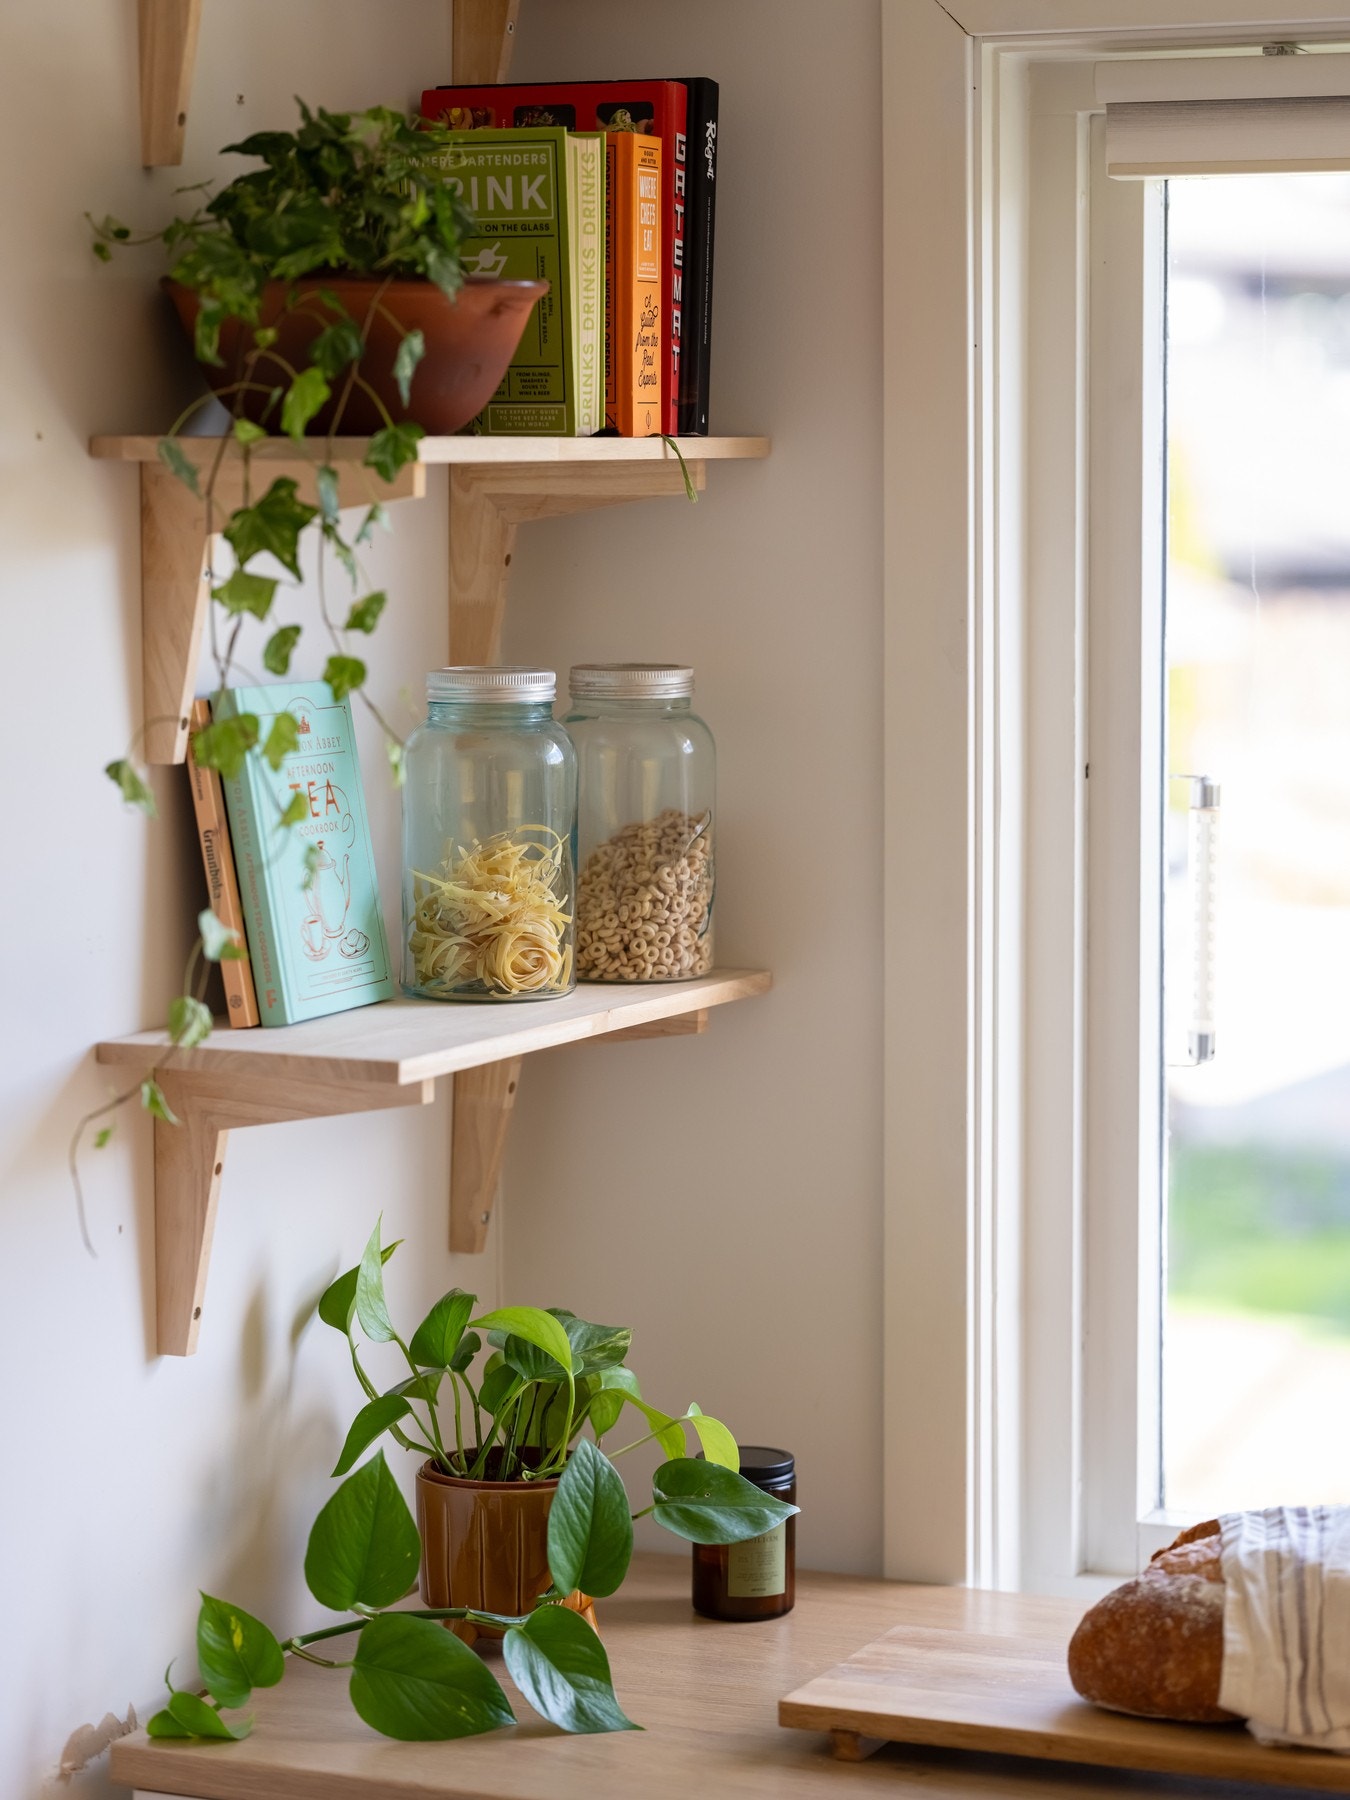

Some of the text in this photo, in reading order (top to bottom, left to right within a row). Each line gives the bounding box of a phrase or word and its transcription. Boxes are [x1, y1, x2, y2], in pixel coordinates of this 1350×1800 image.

[461, 153, 547, 167] ARTENDERS
[410, 175, 548, 212] INK
[639, 175, 657, 199] WHERE
[640, 202, 656, 226] CHEFS
[485, 223, 550, 232] ON THE GLASS
[672, 132, 687, 372] GATEMAT
[583, 151, 596, 427] DRINKS DRINKS DRINKS
[287, 762, 335, 778] AFTERNOON
[299, 822, 339, 837] COOKBOOK
[203, 829, 223, 900] Grunnboka
